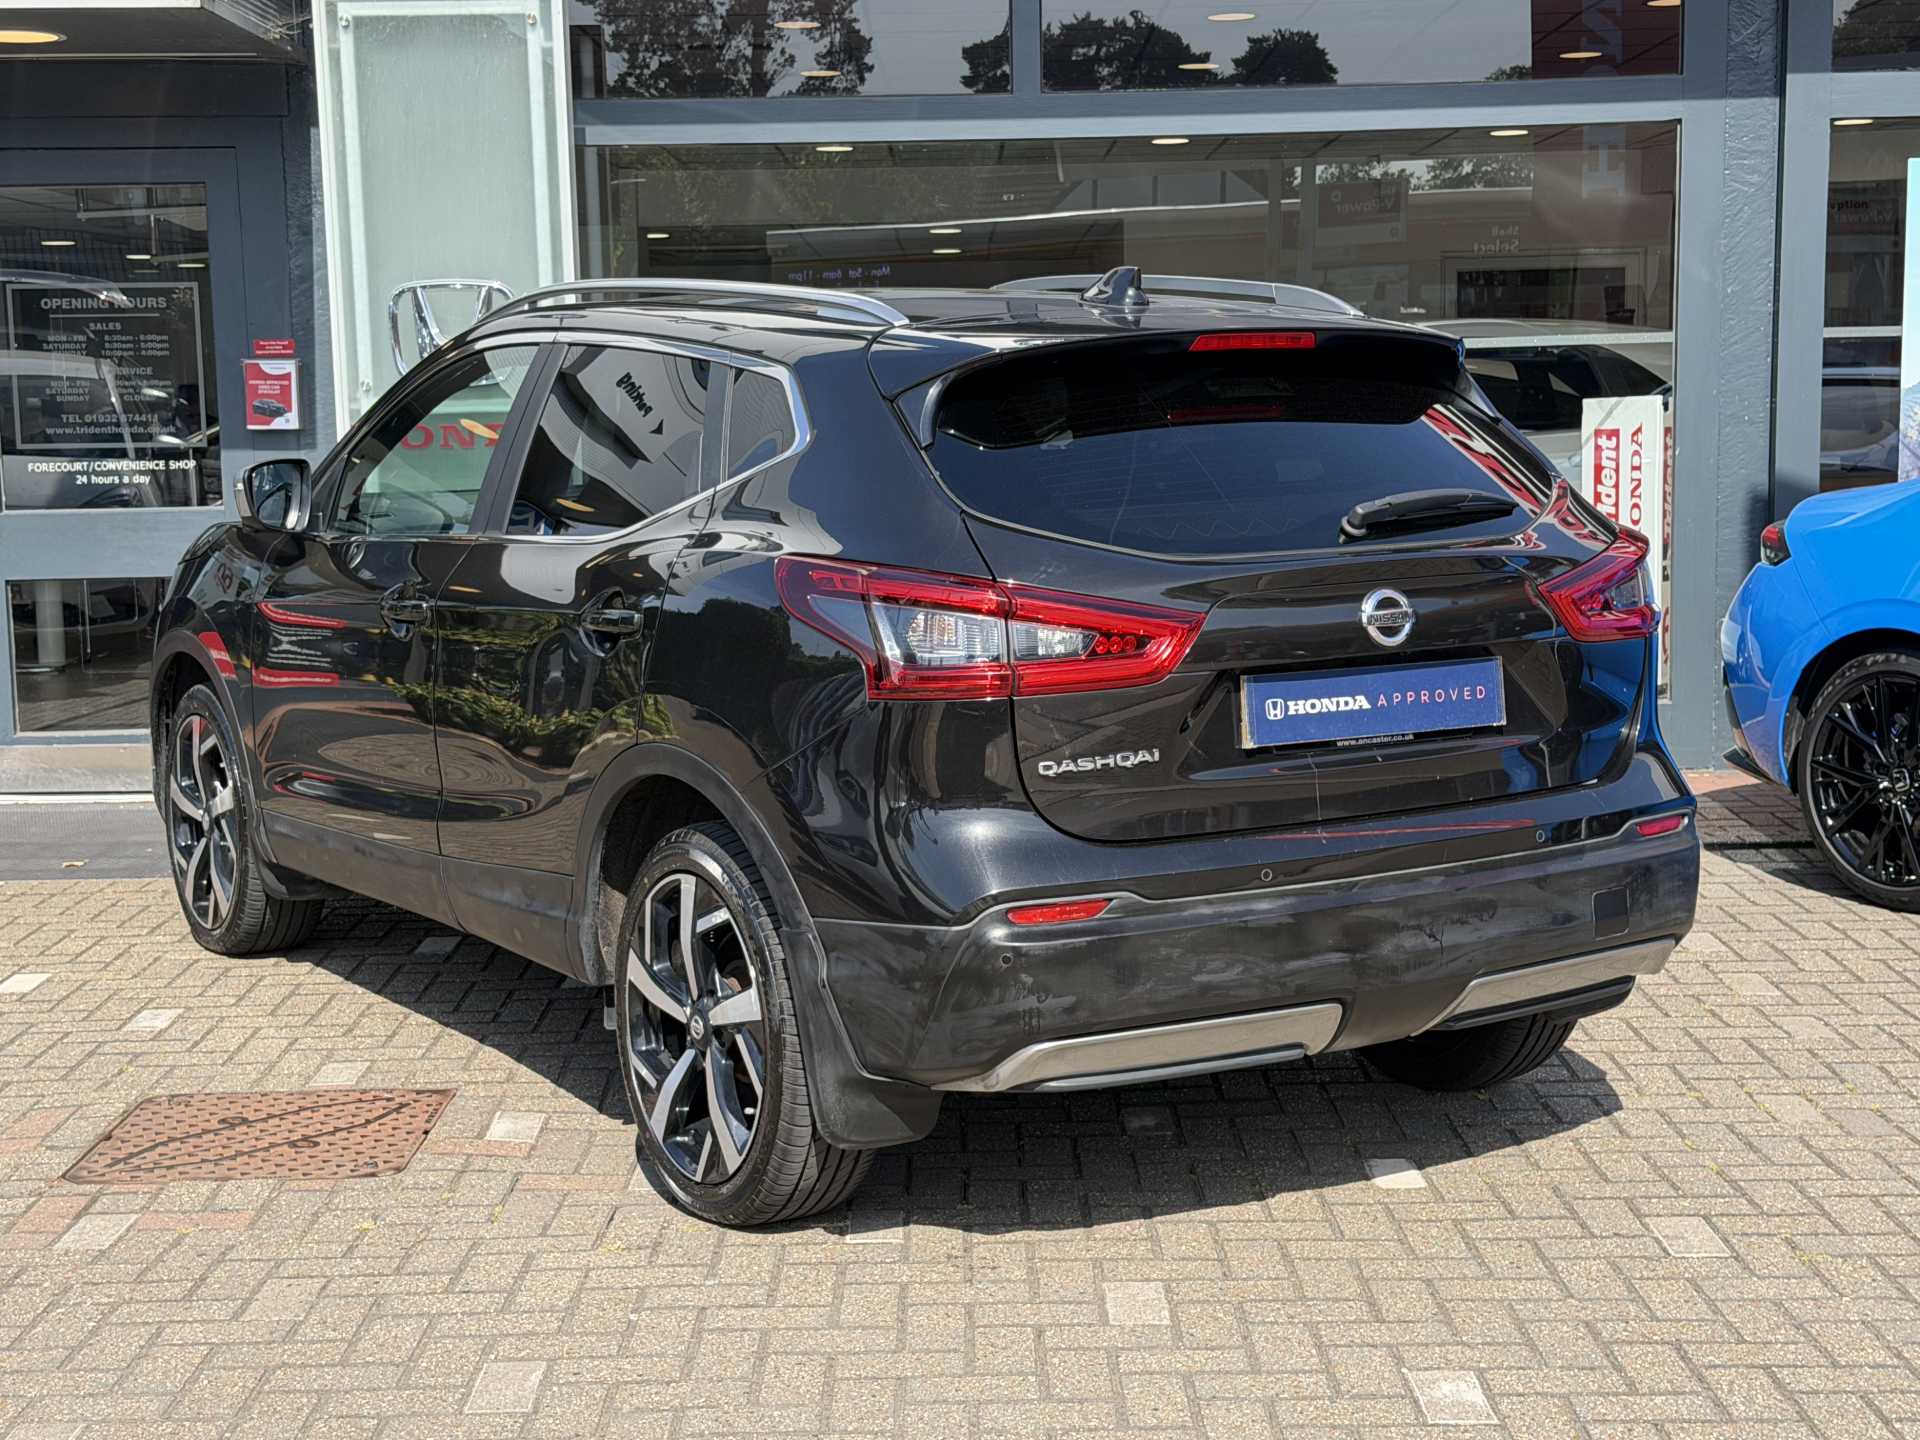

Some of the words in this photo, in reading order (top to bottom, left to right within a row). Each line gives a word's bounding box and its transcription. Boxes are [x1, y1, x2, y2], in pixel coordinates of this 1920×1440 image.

[40, 297, 109, 309] OPENING
[88, 322, 121, 330] SALES
[116, 366, 153, 375] ERVICE
[61, 414, 82, 423] TEL
[27, 460, 166, 473] FORECOURT/CONVENIENCE
[168, 459, 197, 470] SHOP
[75, 474, 88, 485] 24
[91, 474, 119, 485] hours
[122, 475, 130, 484] a
[133, 473, 151, 485] day
[1629, 422, 1643, 527] ONDA
[1287, 695, 1371, 716] HONDA
[1377, 685, 1486, 708] APPROVED
[1038, 748, 1160, 777] QASHQAI
